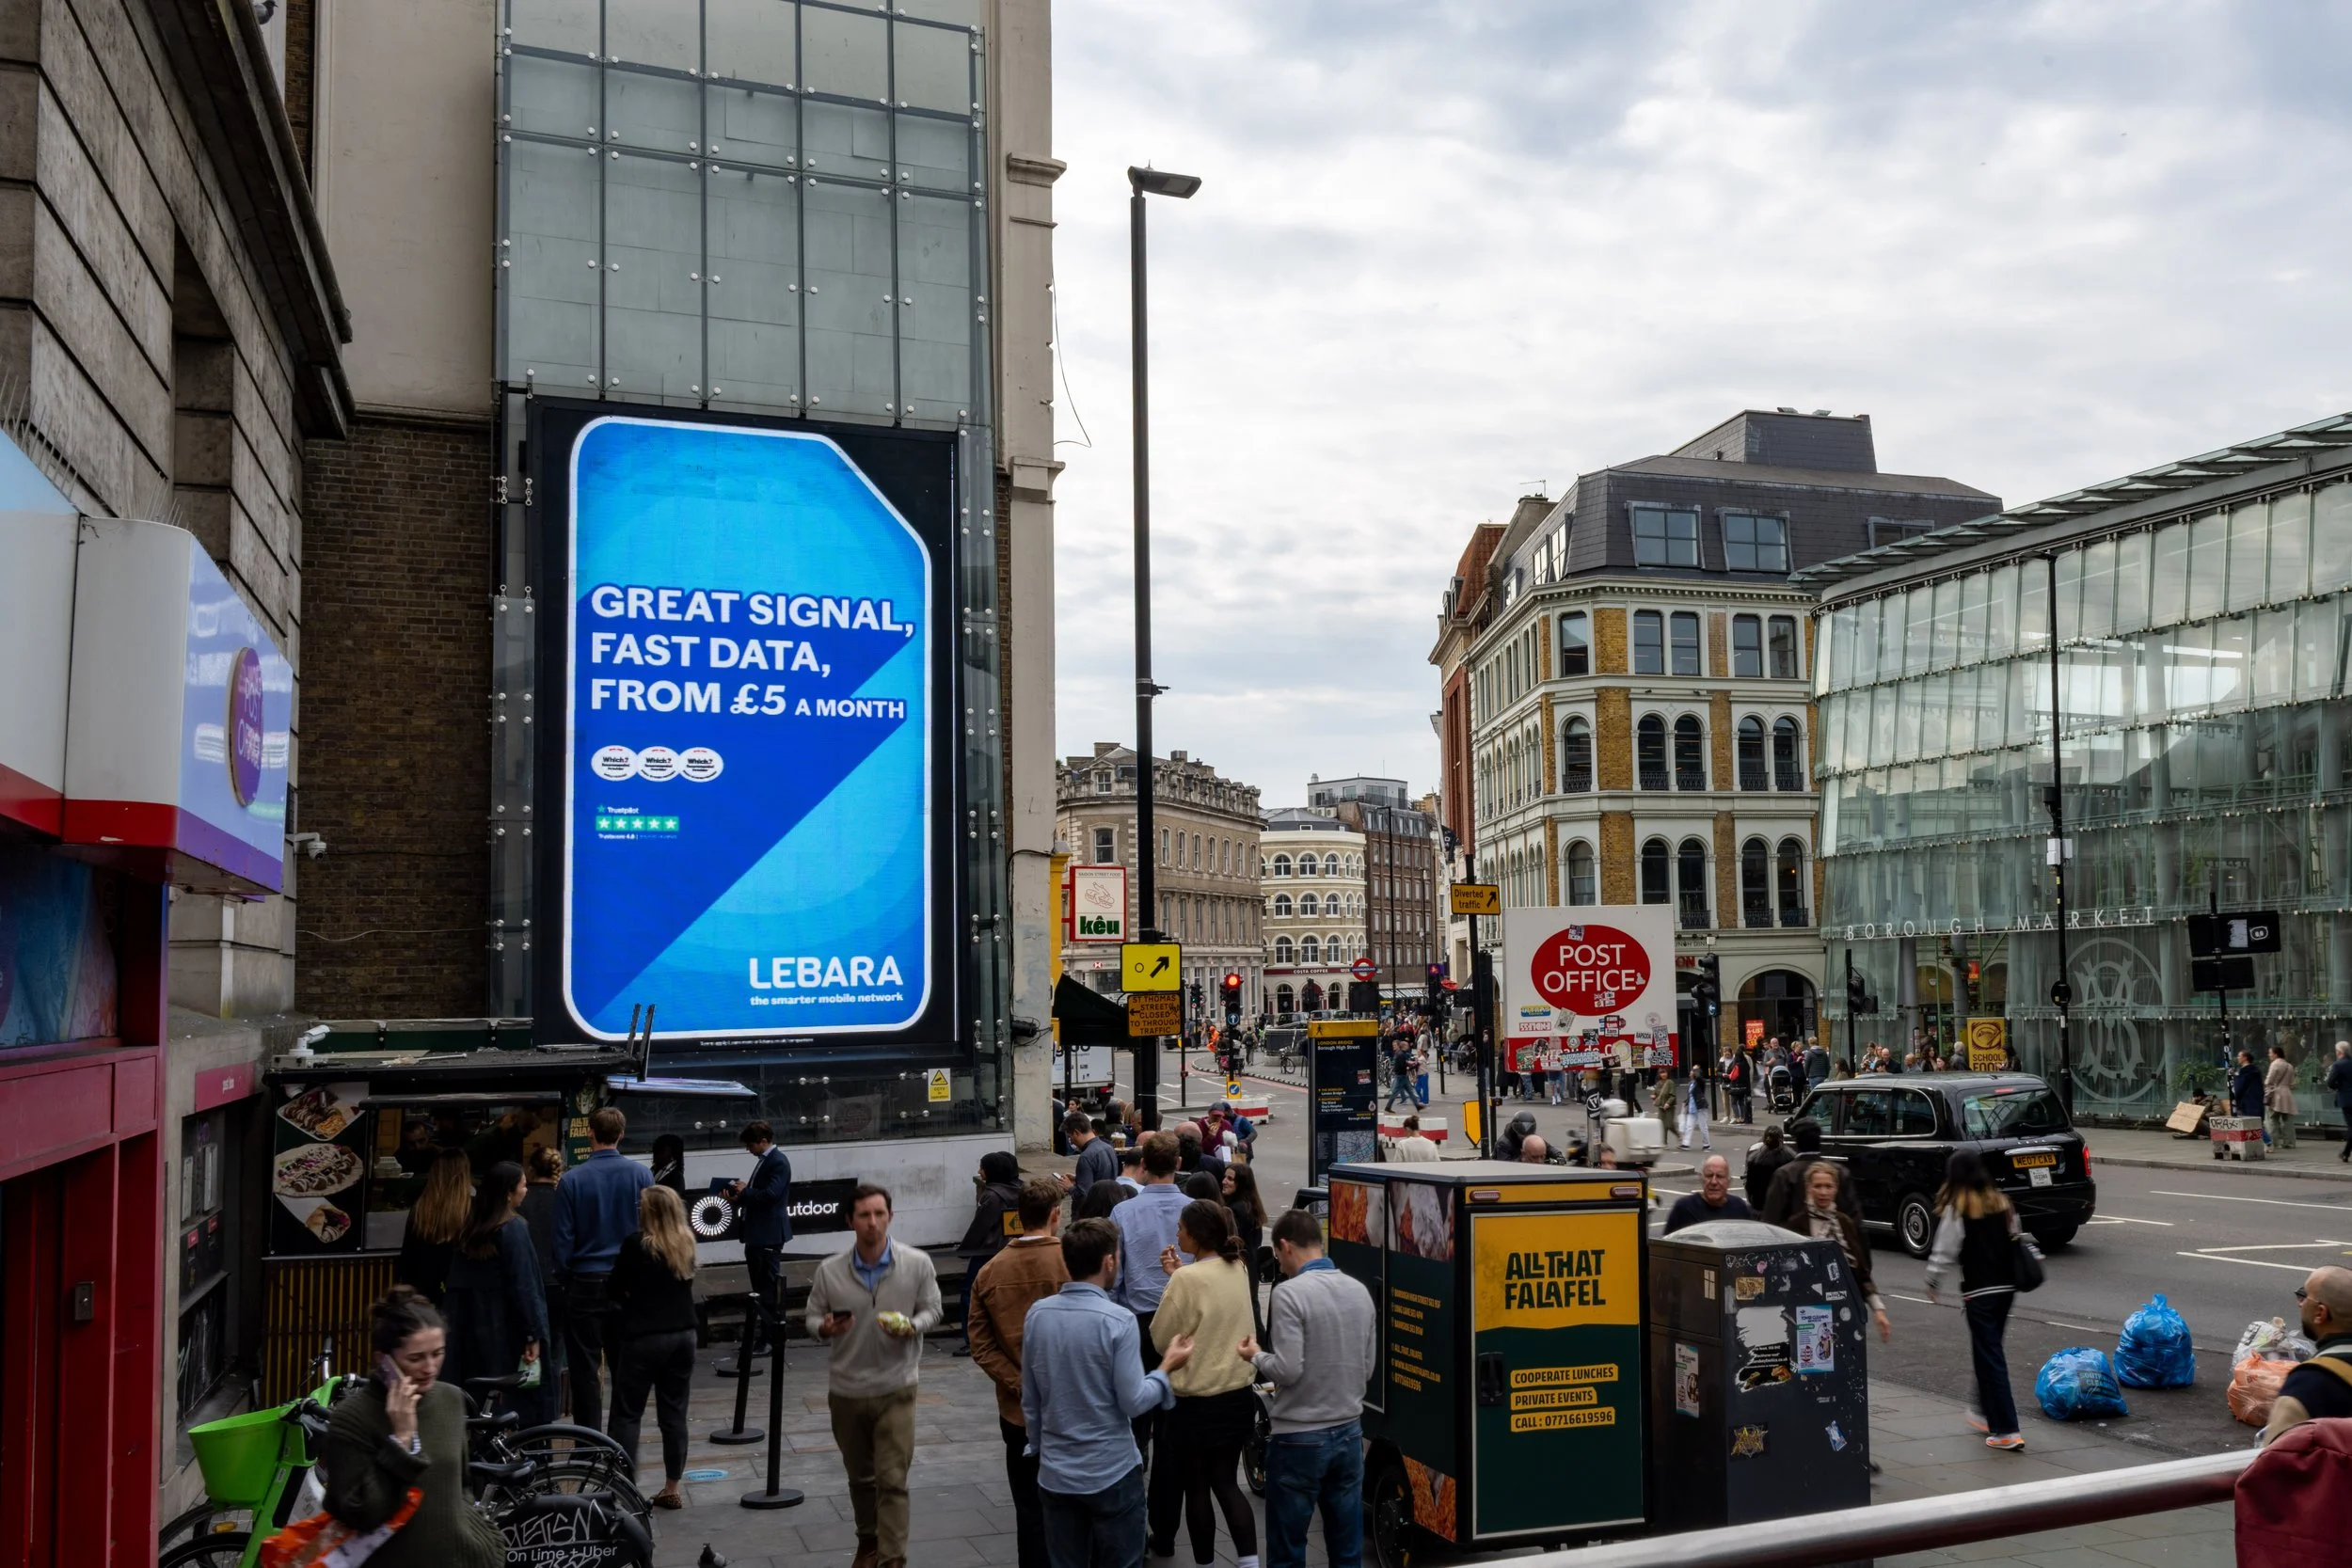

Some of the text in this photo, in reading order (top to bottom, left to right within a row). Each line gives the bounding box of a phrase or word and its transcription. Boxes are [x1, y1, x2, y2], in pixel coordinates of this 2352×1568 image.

[591, 585, 914, 638] GREAT SIGNAL,
[592, 632, 831, 677] FAST DATA,
[591, 678, 905, 719] FROM £5 A MONTH
[607, 806, 639, 815] Trustpilot
[1454, 889, 1484, 898] Diverted
[1458, 900, 1481, 909] traffic
[1079, 915, 1120, 935] kêu
[1847, 907, 2154, 940] BOROUGH MARKET
[1560, 943, 1626, 966] POST
[749, 956, 904, 990] LEBARA
[1543, 969, 1636, 992] OFFICE
[750, 991, 904, 1006] the smarter mobile network
[1144, 994, 1176, 1003] THOMAS
[1973, 1063, 2002, 1071] FOO
[787, 1201, 839, 1216] utdoor
[1505, 1249, 1605, 1280] ALL THAT
[1505, 1279, 1606, 1310] FALAFEL
[1515, 1367, 1613, 1384] COOPERATE LUNCHES
[1515, 1390, 1593, 1406] PRIVATE EVENTS
[1545, 1411, 1613, 1426] 07716619596
[506, 1550, 527, 1562] On
[531, 1548, 564, 1561] Lime
[582, 1545, 618, 1558] Uber
